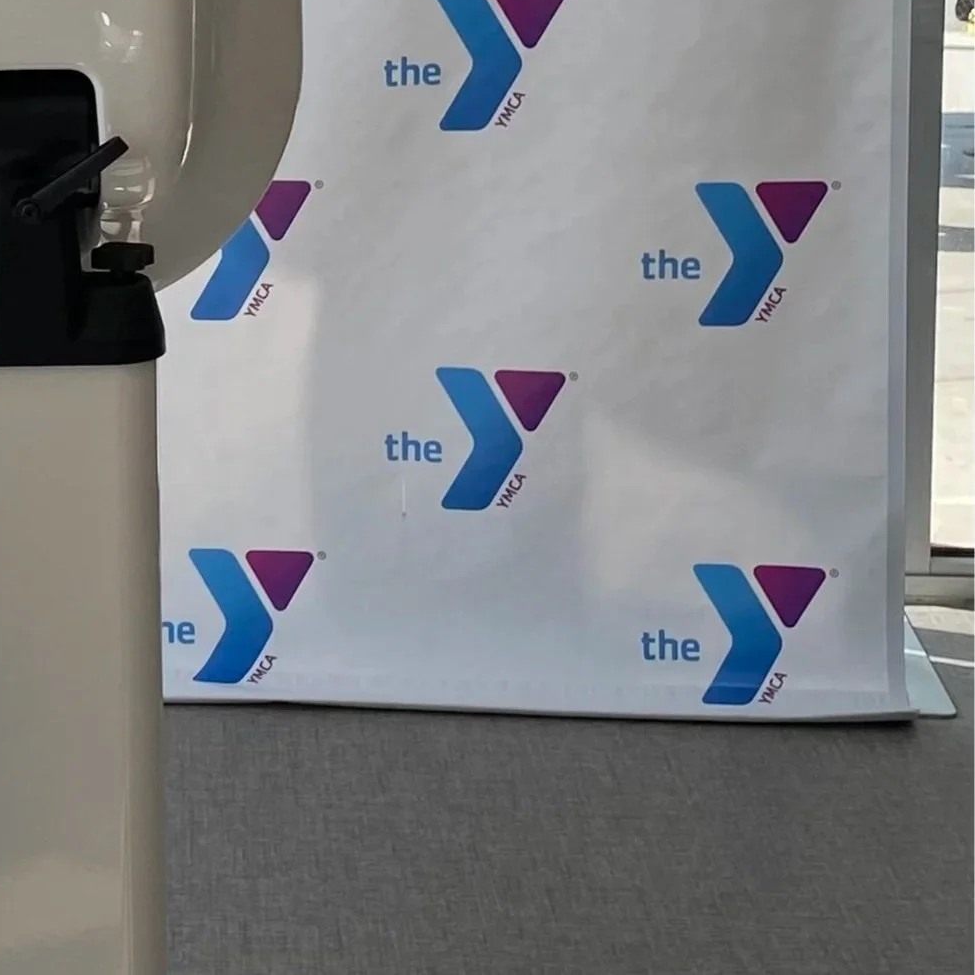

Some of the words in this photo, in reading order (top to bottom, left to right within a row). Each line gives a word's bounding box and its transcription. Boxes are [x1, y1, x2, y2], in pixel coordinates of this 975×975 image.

[384, 56, 441, 87] the
[495, 92, 526, 127] YMCA
[642, 249, 700, 279] the
[244, 283, 273, 316] YMCA
[755, 287, 787, 322] YMCA
[385, 431, 442, 463] the
[496, 474, 526, 508] YMCA
[642, 629, 700, 661] the
[247, 655, 277, 683] YMCA
[758, 673, 787, 704] YMCA
